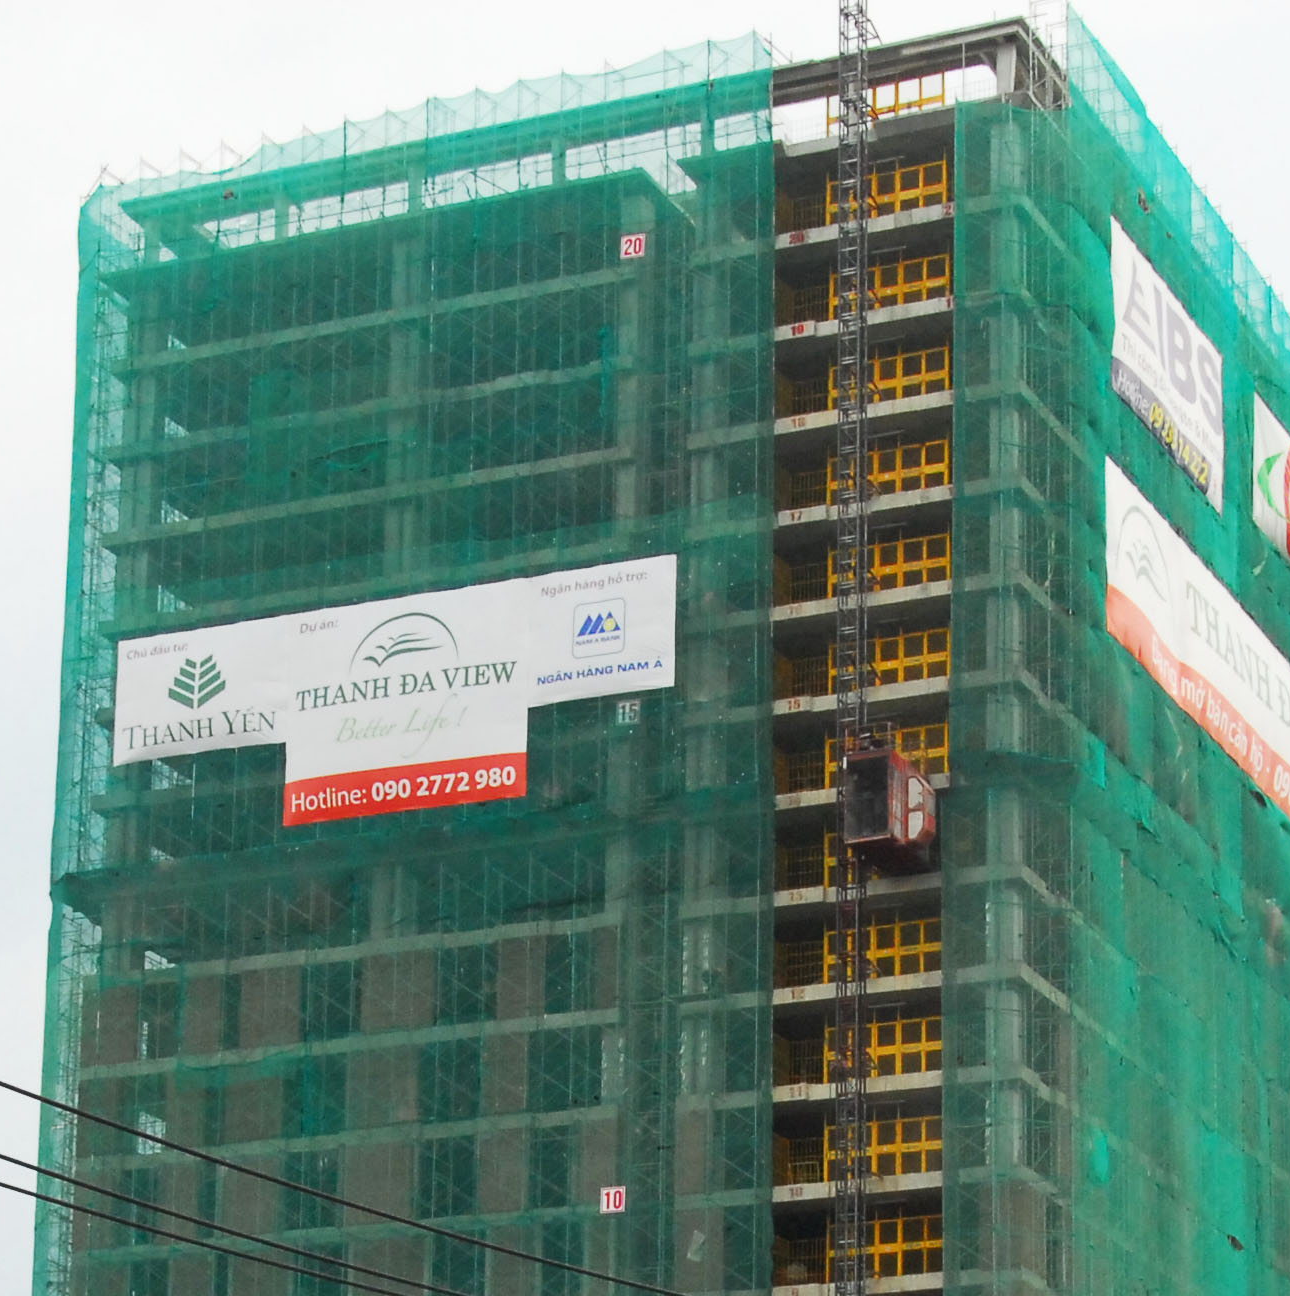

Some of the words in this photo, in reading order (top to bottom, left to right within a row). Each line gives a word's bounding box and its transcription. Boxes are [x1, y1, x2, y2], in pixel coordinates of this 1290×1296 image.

[623, 236, 643, 256] 20
[1185, 579, 1273, 711] THANH
[617, 660, 649, 673] NAM
[295, 676, 392, 712] THANH
[399, 671, 437, 696] ĐA
[441, 660, 518, 689] VIEW
[619, 702, 640, 723] 15
[122, 717, 214, 750] THANH
[335, 716, 398, 744] Better
[290, 787, 367, 813] Hotline:
[371, 778, 411, 802] 090
[416, 771, 470, 796] 2772
[474, 765, 517, 788] 980
[604, 1189, 622, 1210] 10
